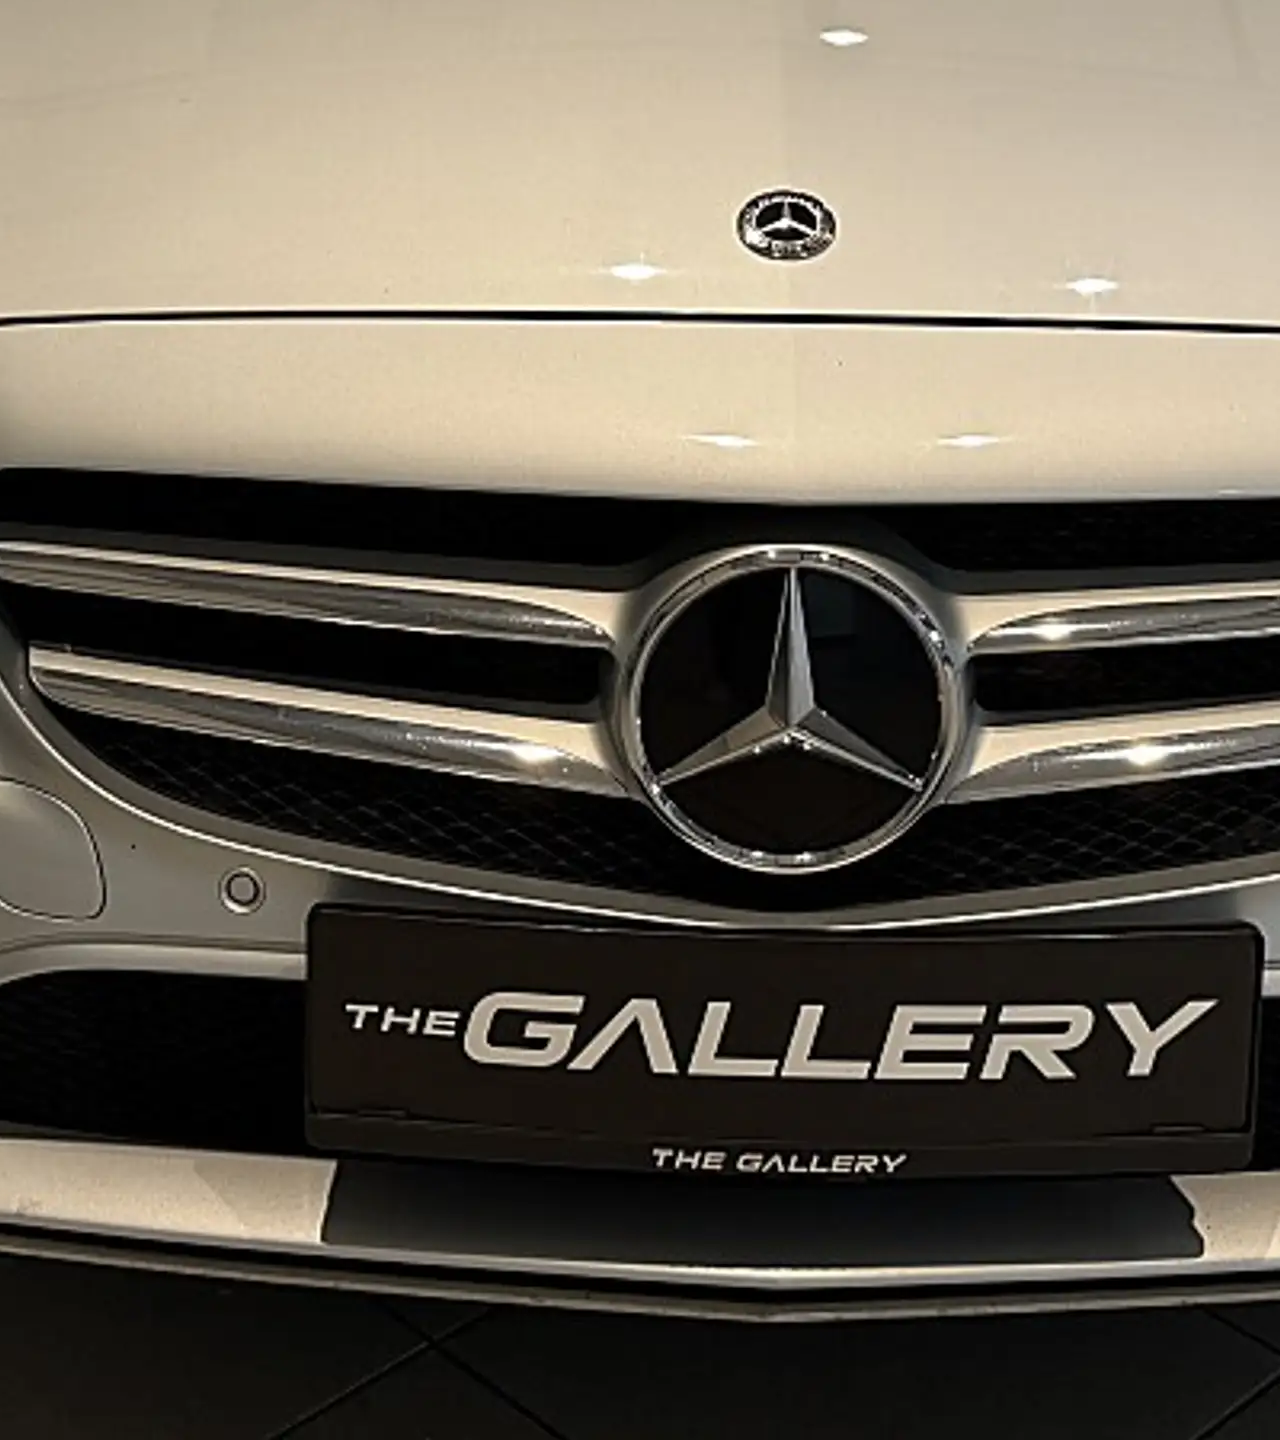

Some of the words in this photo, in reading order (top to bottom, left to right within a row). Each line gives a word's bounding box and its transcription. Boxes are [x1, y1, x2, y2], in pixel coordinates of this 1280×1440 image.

[345, 1003, 461, 1037] THE
[463, 991, 1219, 1080] GALLERY
[652, 1147, 727, 1171] THE
[735, 1153, 907, 1174] GALLERY
